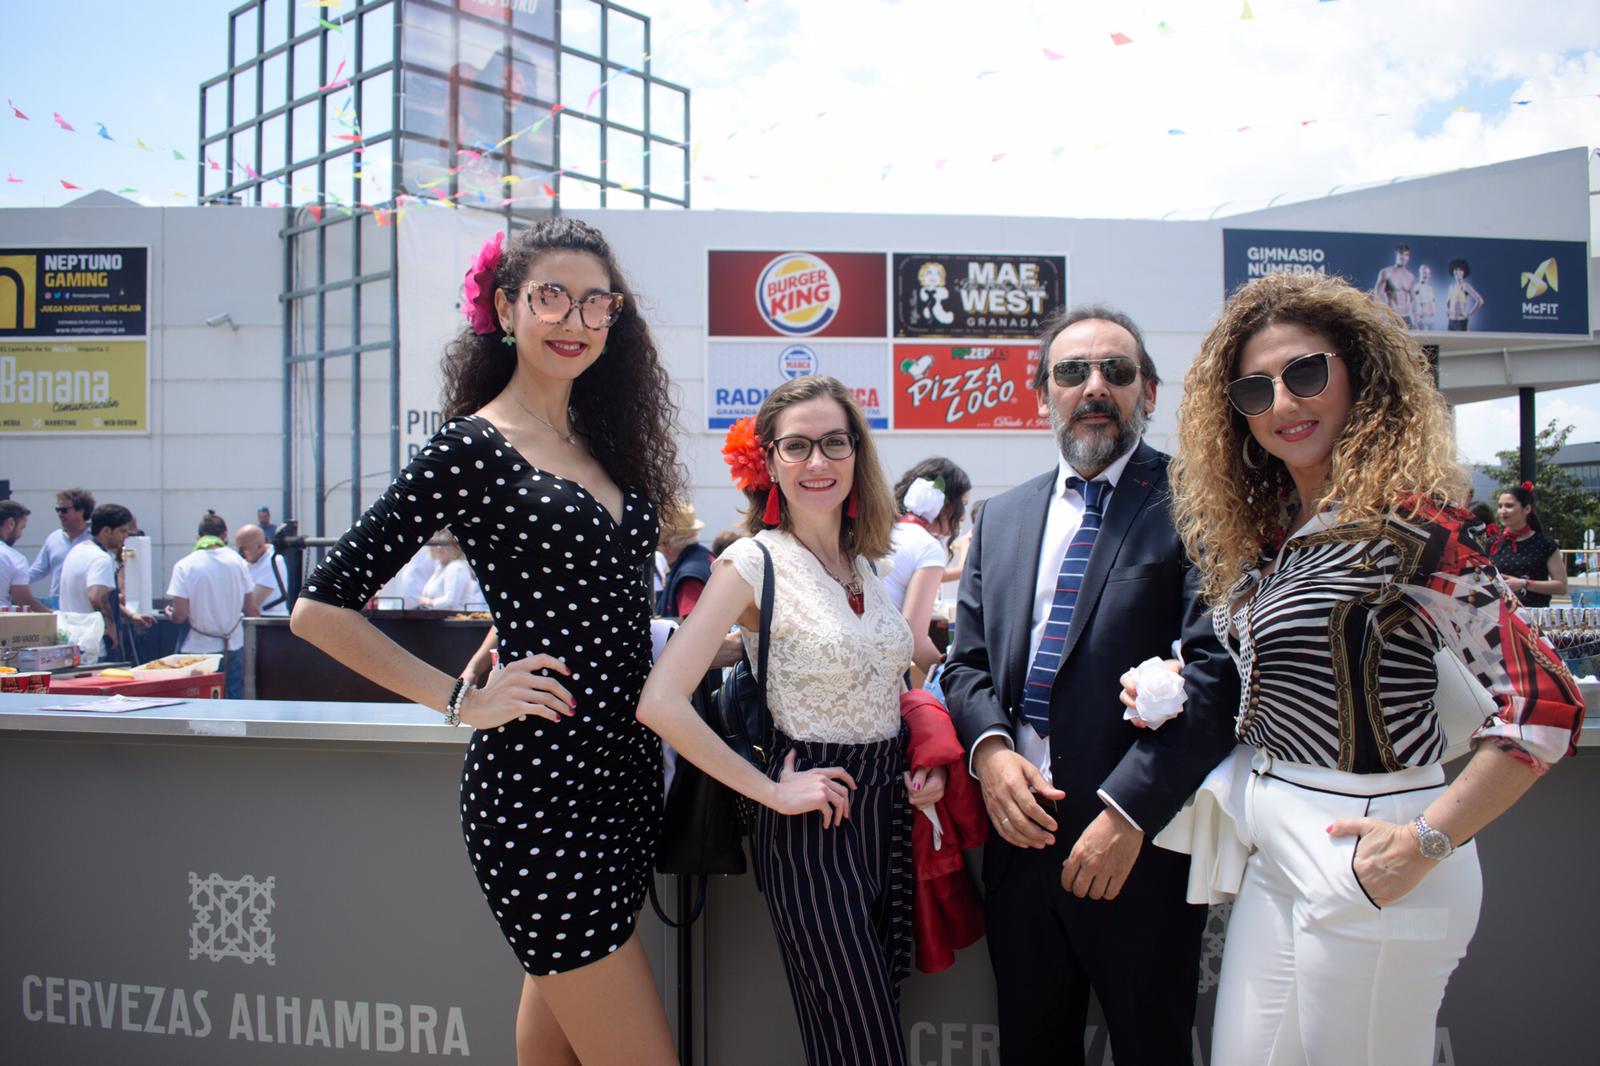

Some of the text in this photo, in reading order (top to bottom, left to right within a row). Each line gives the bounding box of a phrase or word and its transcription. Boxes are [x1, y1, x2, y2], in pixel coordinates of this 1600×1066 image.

[44, 254, 122, 271] NEPTUNO
[1247, 246, 1324, 262] GIMNASIO
[44, 272, 108, 288] GAMING
[767, 269, 828, 297] BURGER
[968, 262, 1039, 286] MAE
[770, 283, 830, 318] KING
[960, 288, 1048, 315] WEST
[1522, 302, 1559, 315] McFIT
[966, 317, 1039, 328] GRANADA
[0, 355, 110, 404] Banana
[907, 362, 1002, 408] PIZZA
[716, 388, 769, 405] RADI
[946, 380, 1015, 423] LOCO
[22, 974, 471, 1057] CERVEZAS ALHAMBRA
